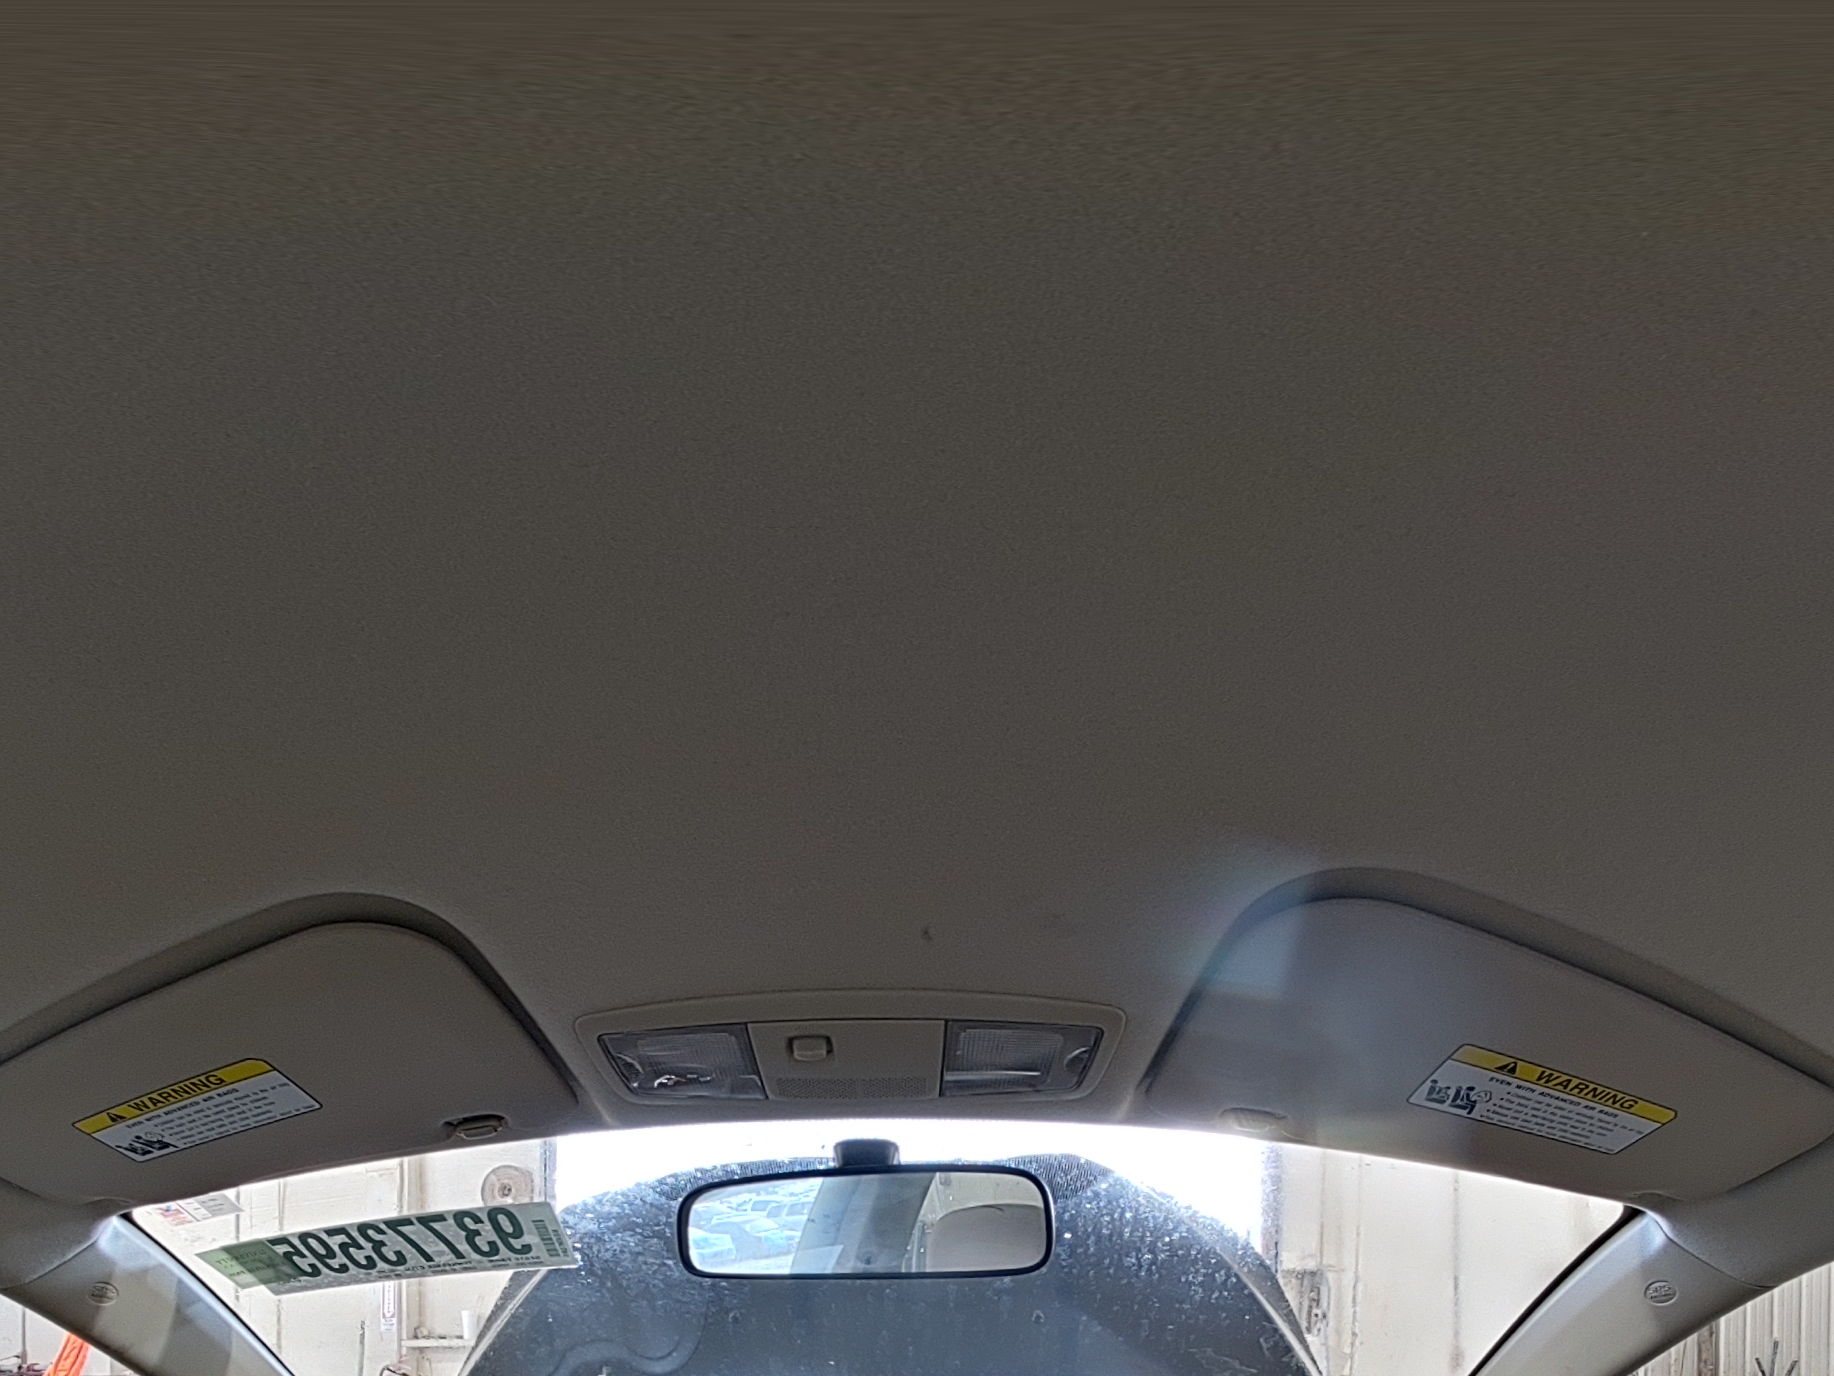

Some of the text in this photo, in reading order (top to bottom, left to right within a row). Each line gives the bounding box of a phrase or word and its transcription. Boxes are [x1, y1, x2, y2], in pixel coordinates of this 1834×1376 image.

[127, 1073, 227, 1113] WARNING
[163, 1100, 201, 1116] ADVANCED
[216, 1087, 240, 1098] BAGS
[1488, 1076, 1513, 1087] EVEN
[1515, 1084, 1537, 1094] WITH
[1538, 1091, 1582, 1107] ADVANCED
[1583, 1104, 1599, 1112] AIR
[1535, 1069, 1639, 1111] WARNING
